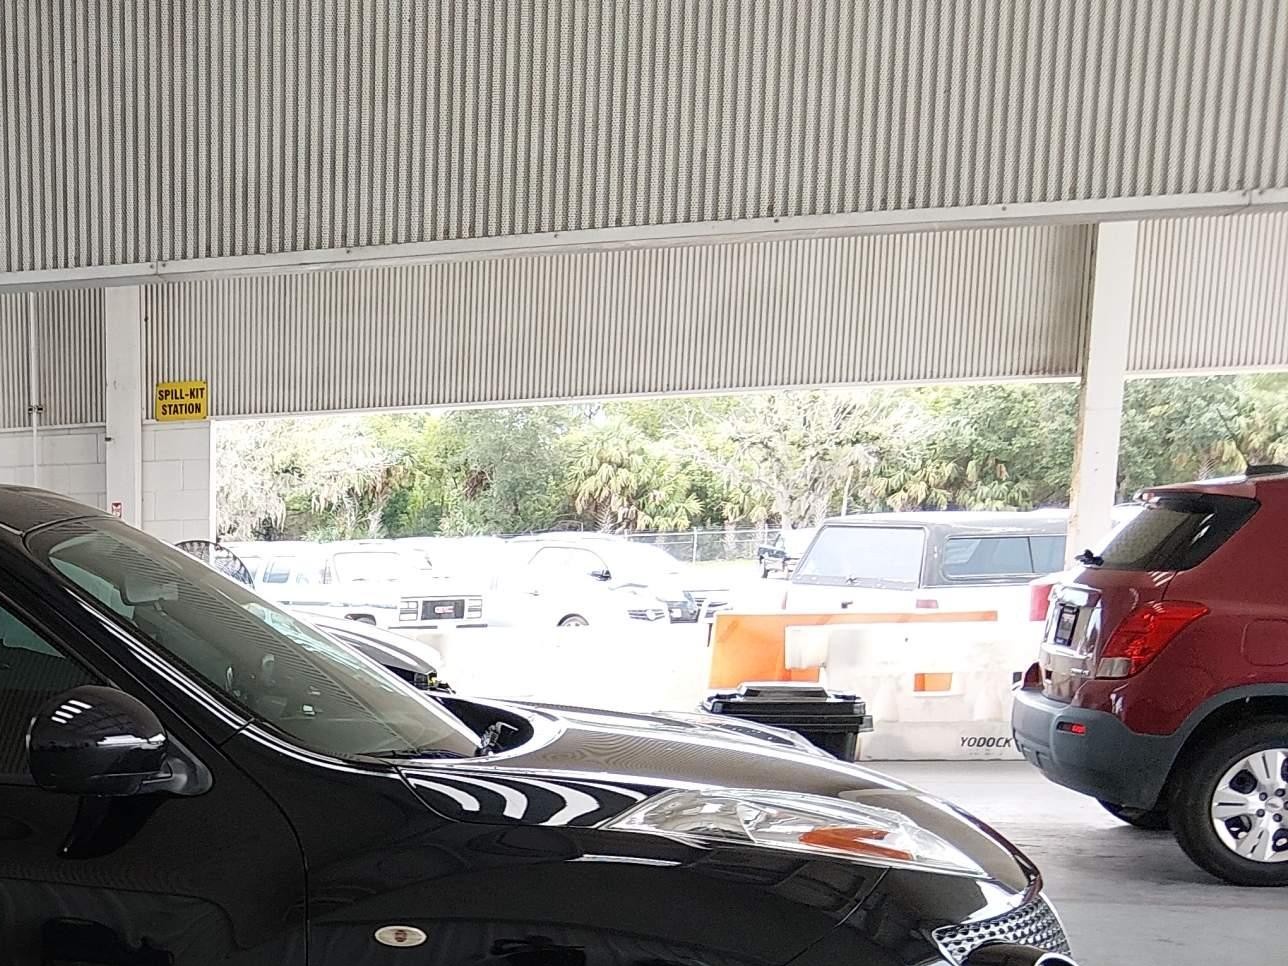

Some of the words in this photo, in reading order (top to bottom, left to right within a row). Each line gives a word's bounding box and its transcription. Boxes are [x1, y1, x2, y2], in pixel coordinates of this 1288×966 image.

[158, 387, 205, 401] SPILL-KIT
[161, 403, 201, 415] STATION
[960, 736, 1013, 748] YODOCK
